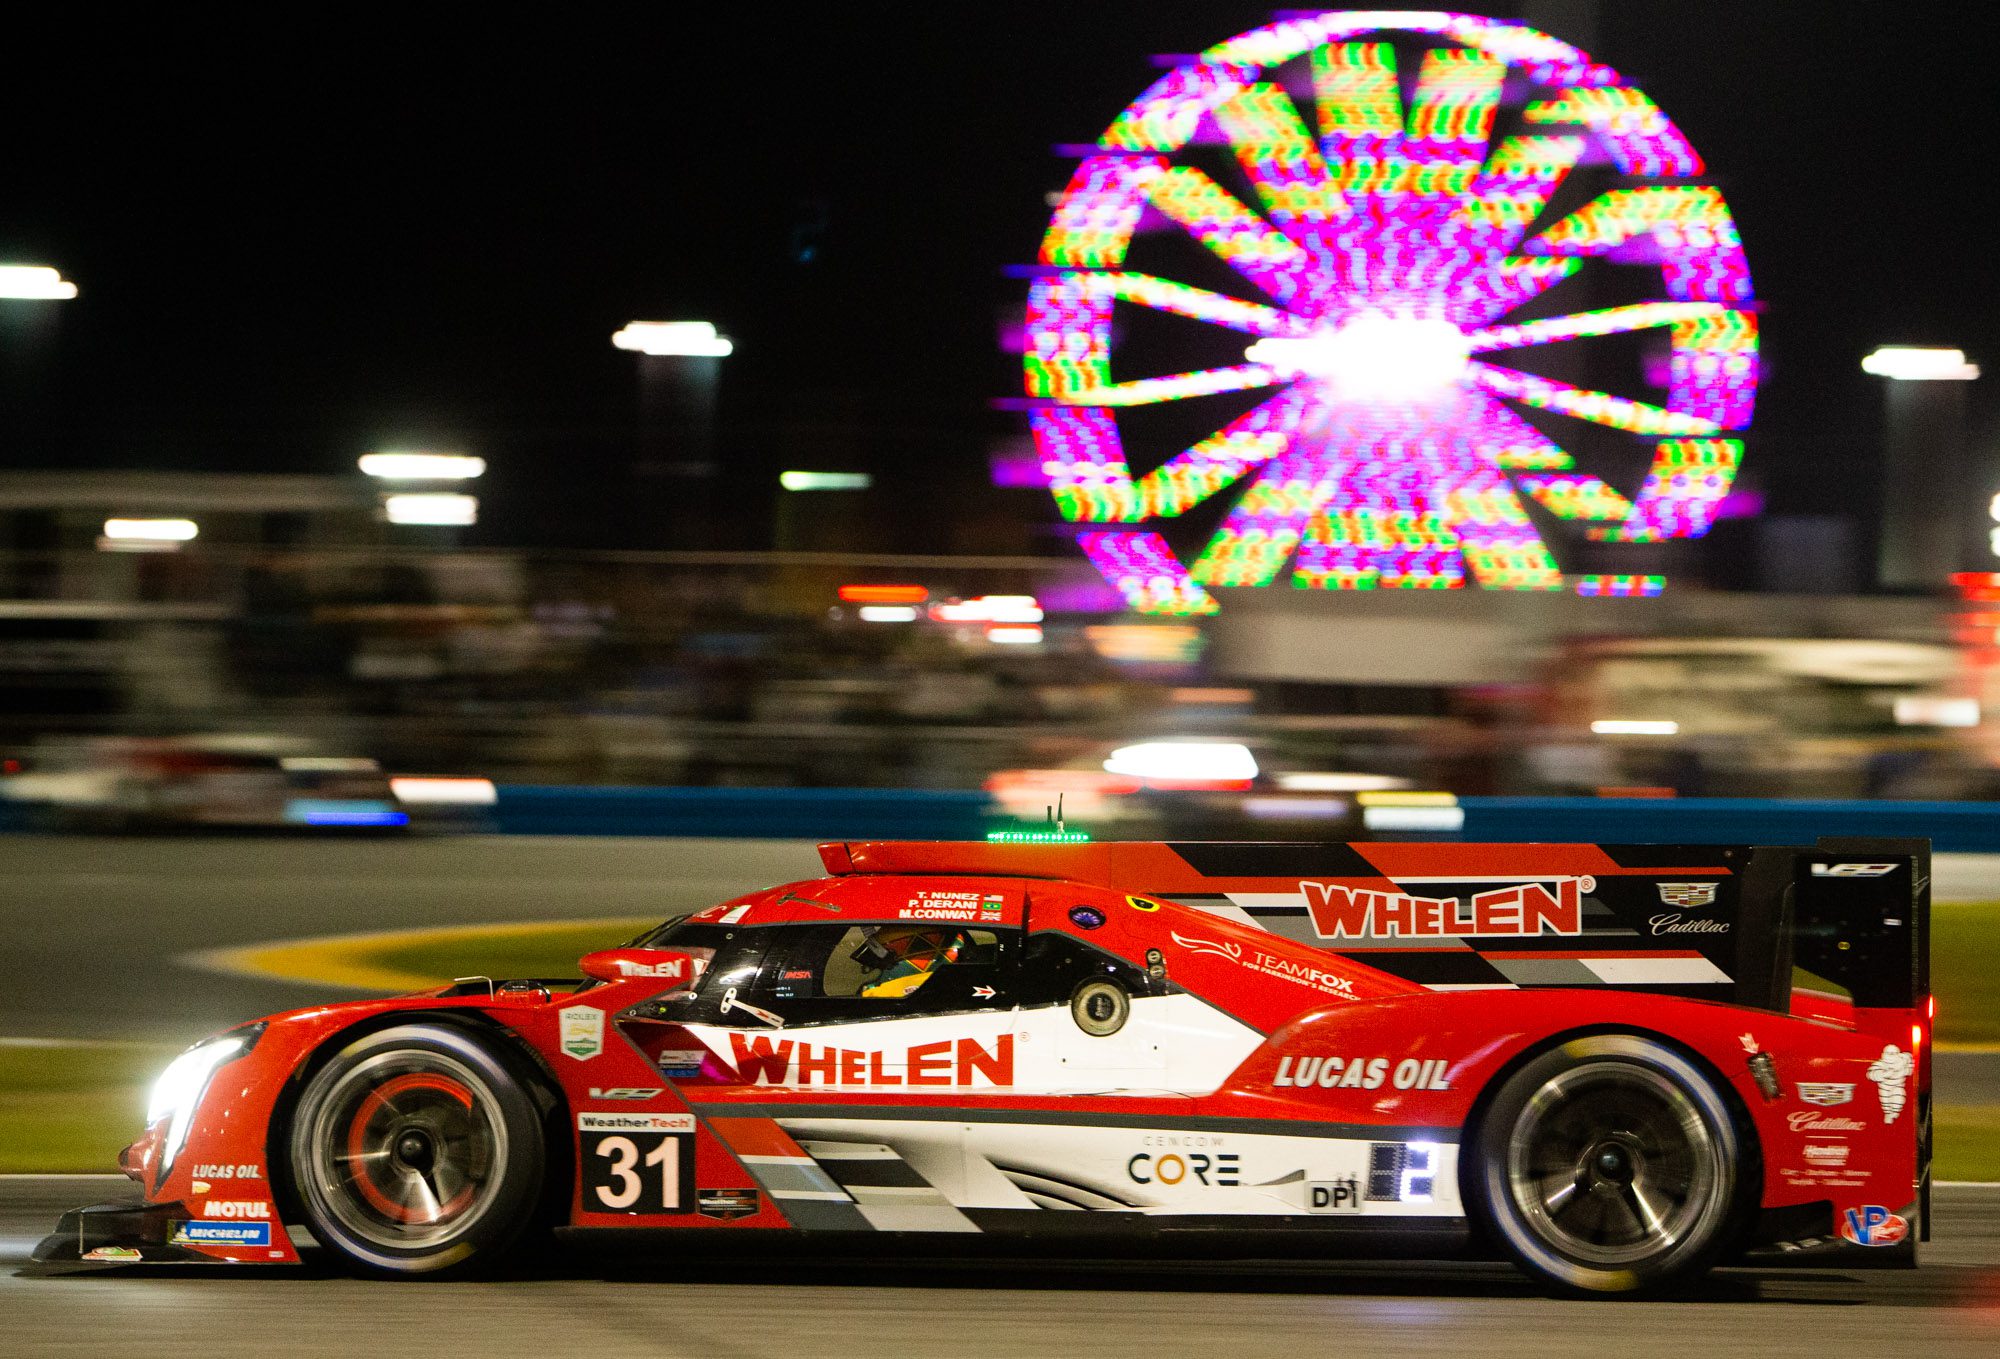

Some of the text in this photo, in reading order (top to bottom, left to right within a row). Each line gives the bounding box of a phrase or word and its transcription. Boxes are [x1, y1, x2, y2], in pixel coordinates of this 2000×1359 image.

[908, 900, 977, 909] P. DERANI
[931, 892, 980, 901] NUNEZ
[1300, 877, 1581, 938] WHELEN
[1648, 913, 1730, 936] Cadillac
[616, 958, 682, 978] WHELEN
[728, 1032, 1014, 1086] WHELEN
[1272, 1056, 1450, 1090] LUCAS OIL
[582, 1117, 689, 1128] WeatherTech
[1786, 1111, 1867, 1132] Cadillac
[192, 1164, 262, 1179] LUCAS OIL
[595, 1136, 679, 1209] 31
[1128, 1153, 1239, 1186] CORE
[1400, 1141, 1439, 1202] 2
[203, 1200, 271, 1218] MOTUL
[189, 1228, 260, 1239] MICHELIN
[1844, 1205, 1889, 1245] VP
